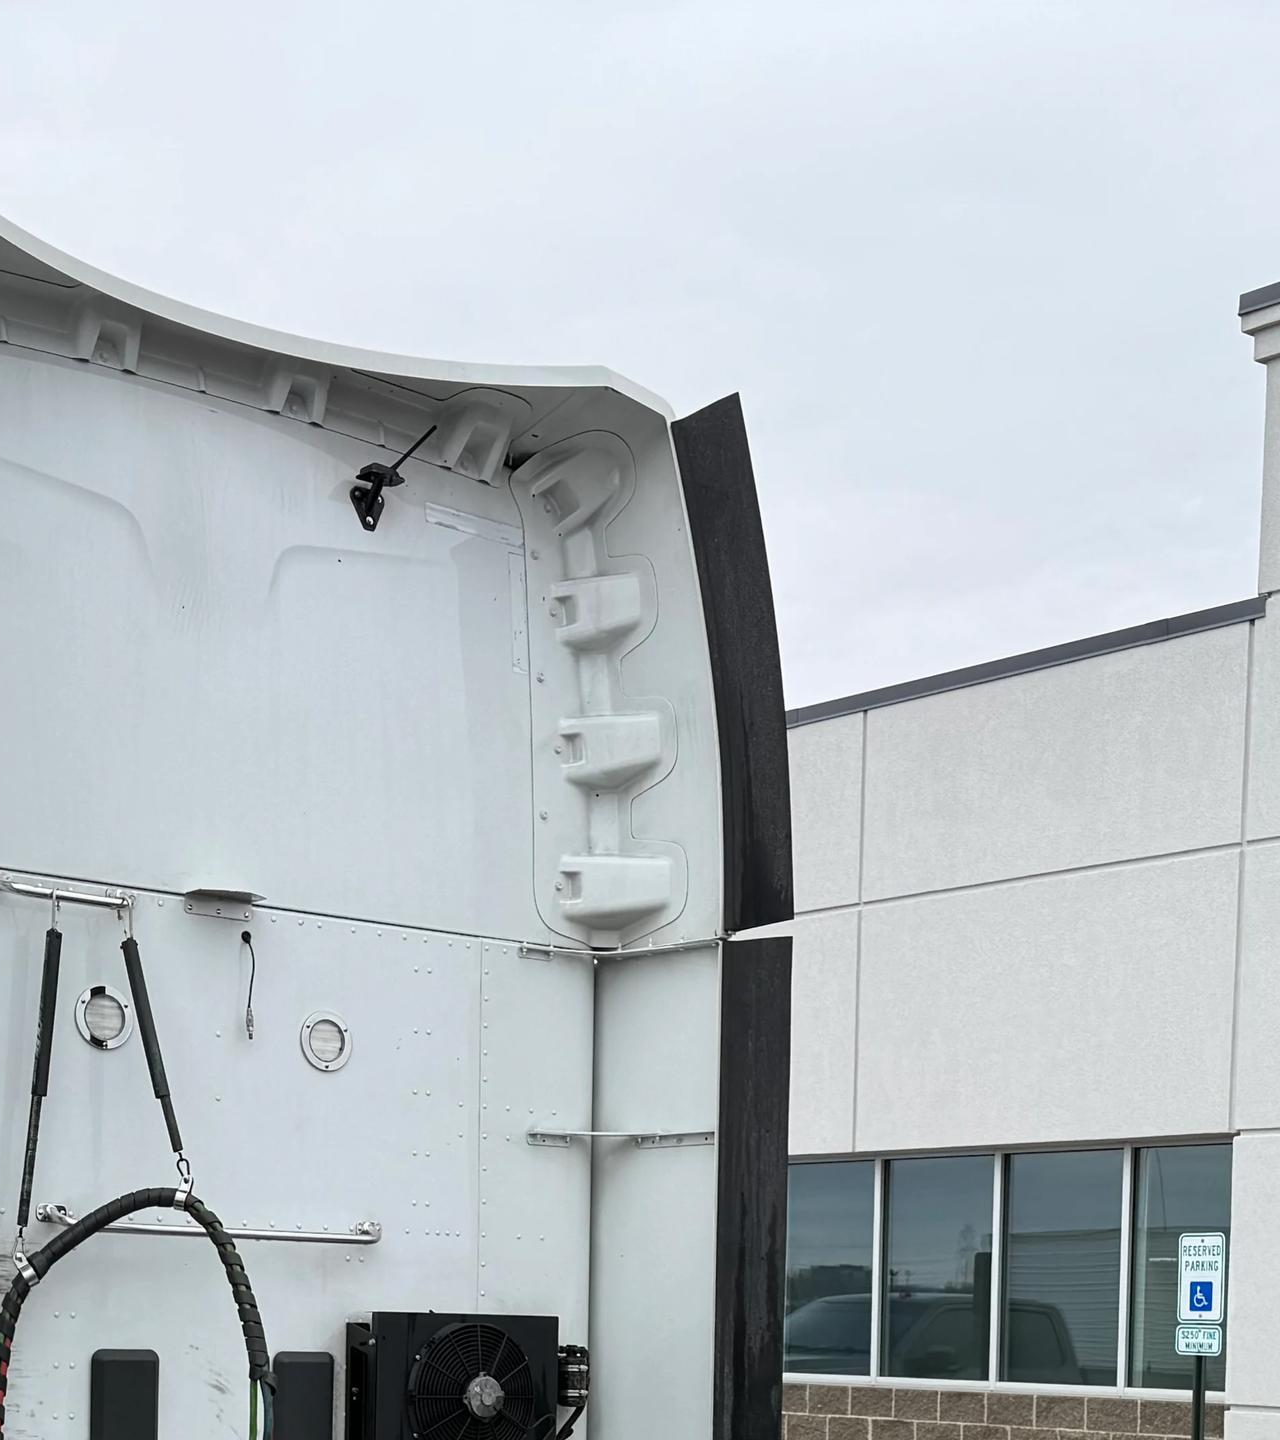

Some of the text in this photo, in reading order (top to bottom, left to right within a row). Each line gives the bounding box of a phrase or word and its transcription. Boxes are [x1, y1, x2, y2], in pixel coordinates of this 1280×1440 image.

[1182, 1245, 1221, 1257] RESERVED
[1184, 1260, 1219, 1272] PARKING
[1185, 1342, 1213, 1351] MINIMUM
